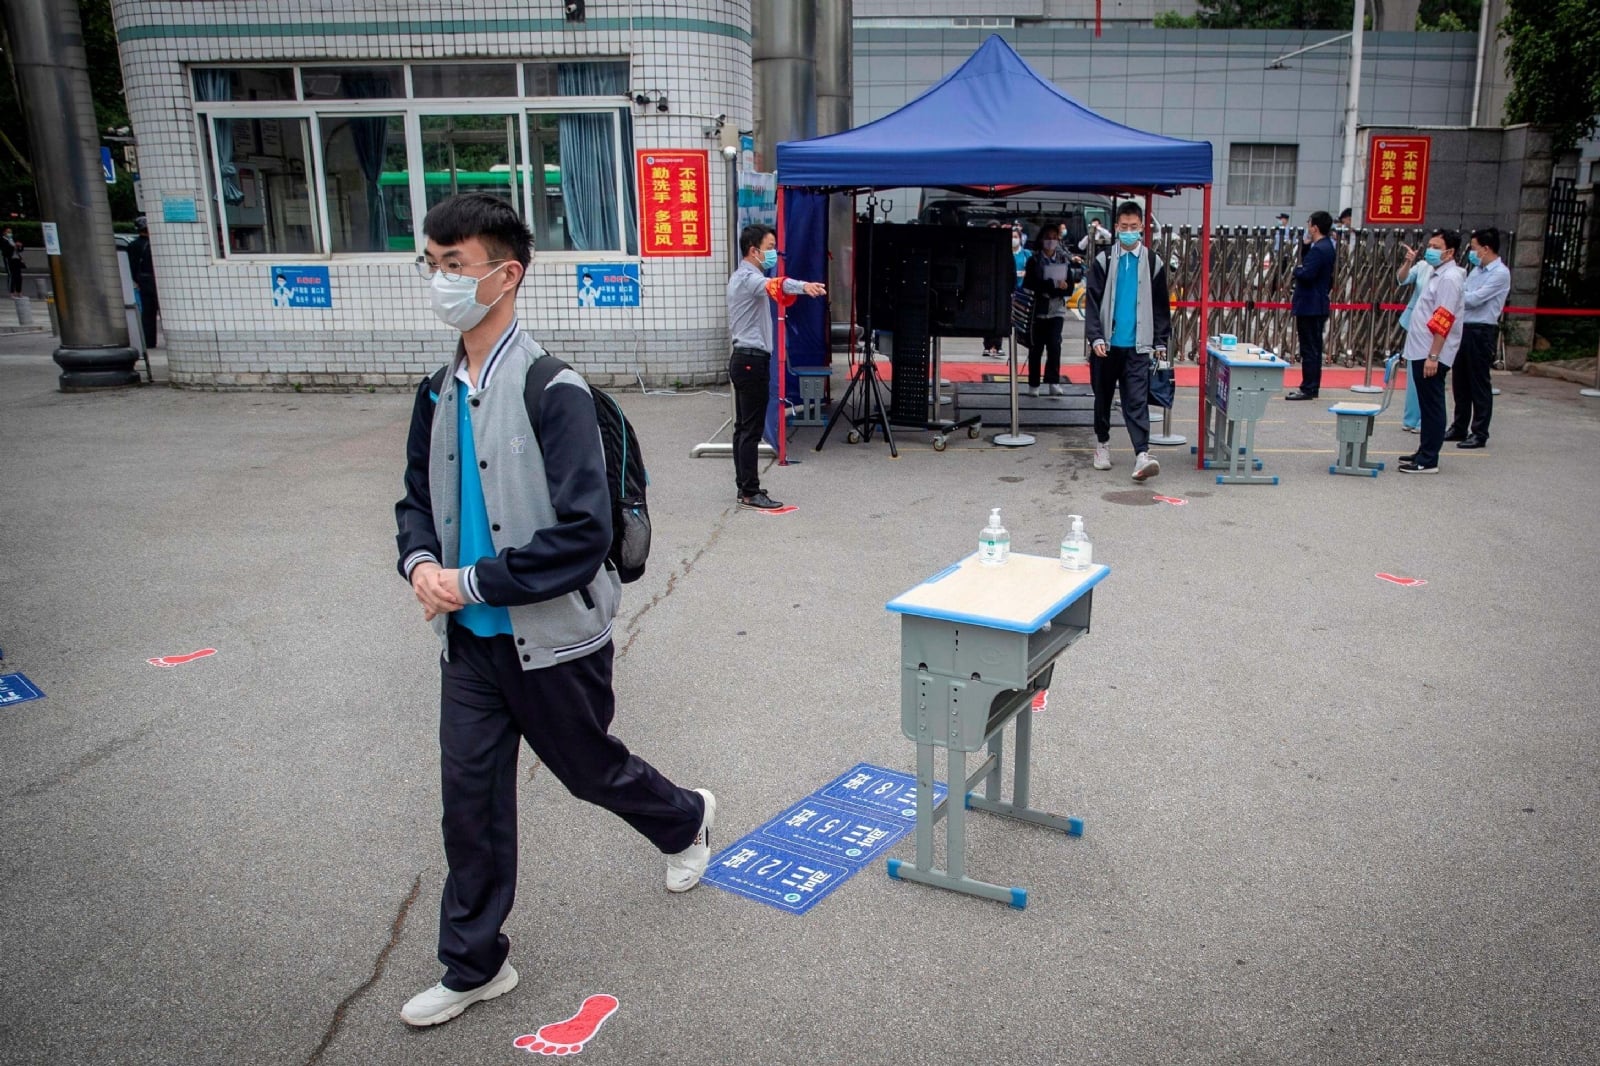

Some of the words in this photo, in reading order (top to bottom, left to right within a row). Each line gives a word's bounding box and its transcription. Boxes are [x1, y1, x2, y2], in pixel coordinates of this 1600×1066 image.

[1402, 151, 1418, 181] 不聚集
[651, 167, 671, 204] 勤洗手
[679, 167, 697, 204] 不聚集
[654, 210, 673, 246] 多通风
[680, 210, 699, 246] 戴口罩
[842, 773, 940, 808] 三(8)班
[785, 808, 890, 848] 高三(5)班
[722, 848, 832, 892] 高三(2)班
